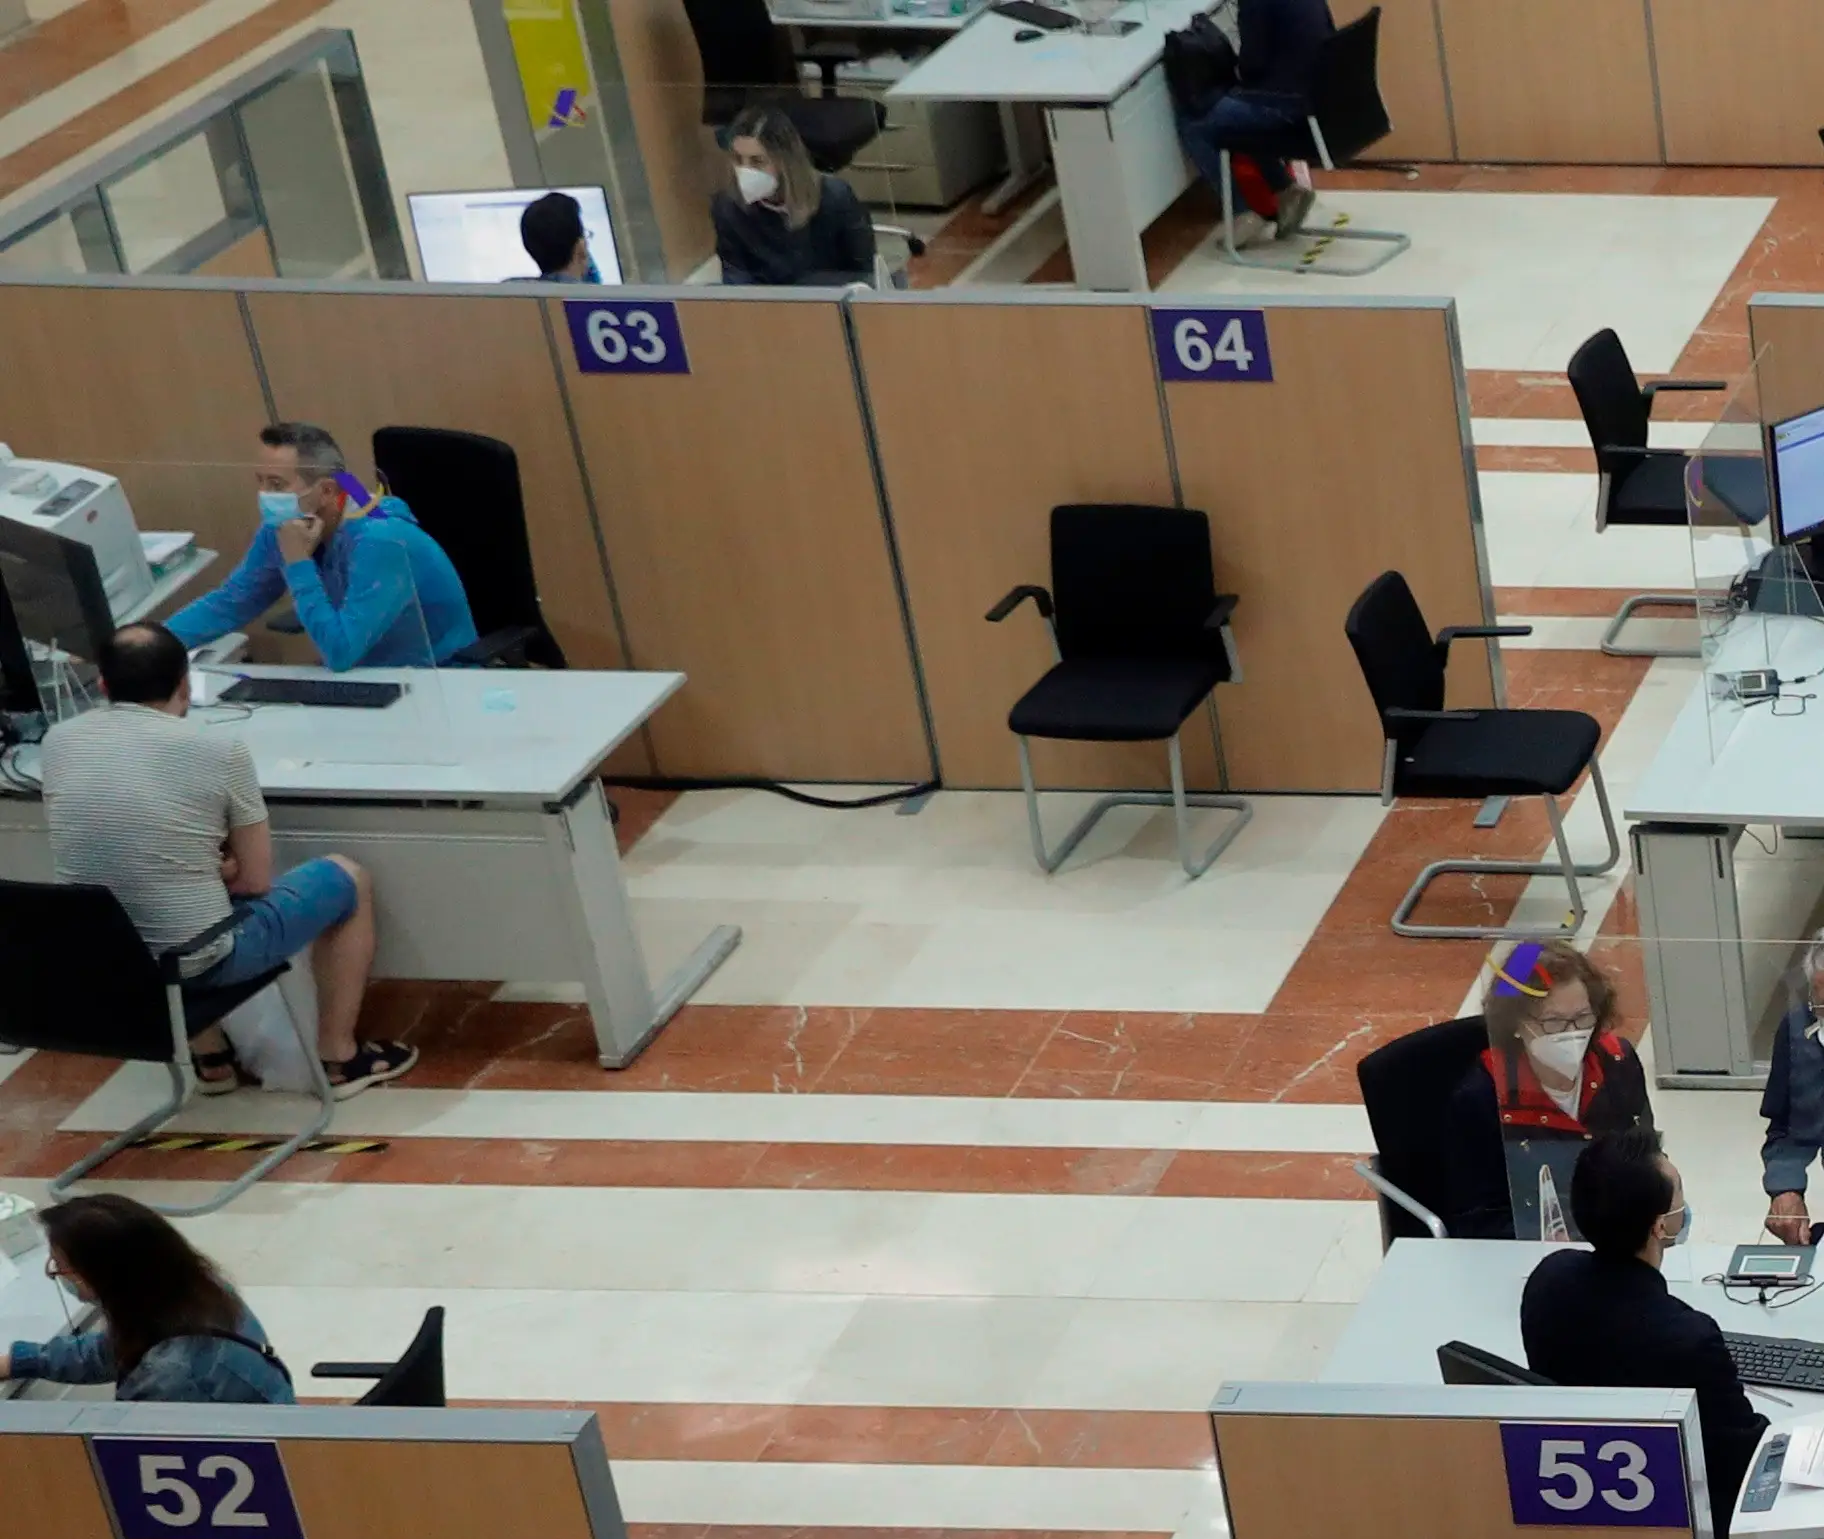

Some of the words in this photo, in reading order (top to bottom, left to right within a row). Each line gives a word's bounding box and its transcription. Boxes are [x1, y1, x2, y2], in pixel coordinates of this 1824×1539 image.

[587, 309, 666, 363] 63
[1174, 318, 1253, 371] 64
[138, 1454, 269, 1527] 52
[1538, 1439, 1655, 1511] 53
